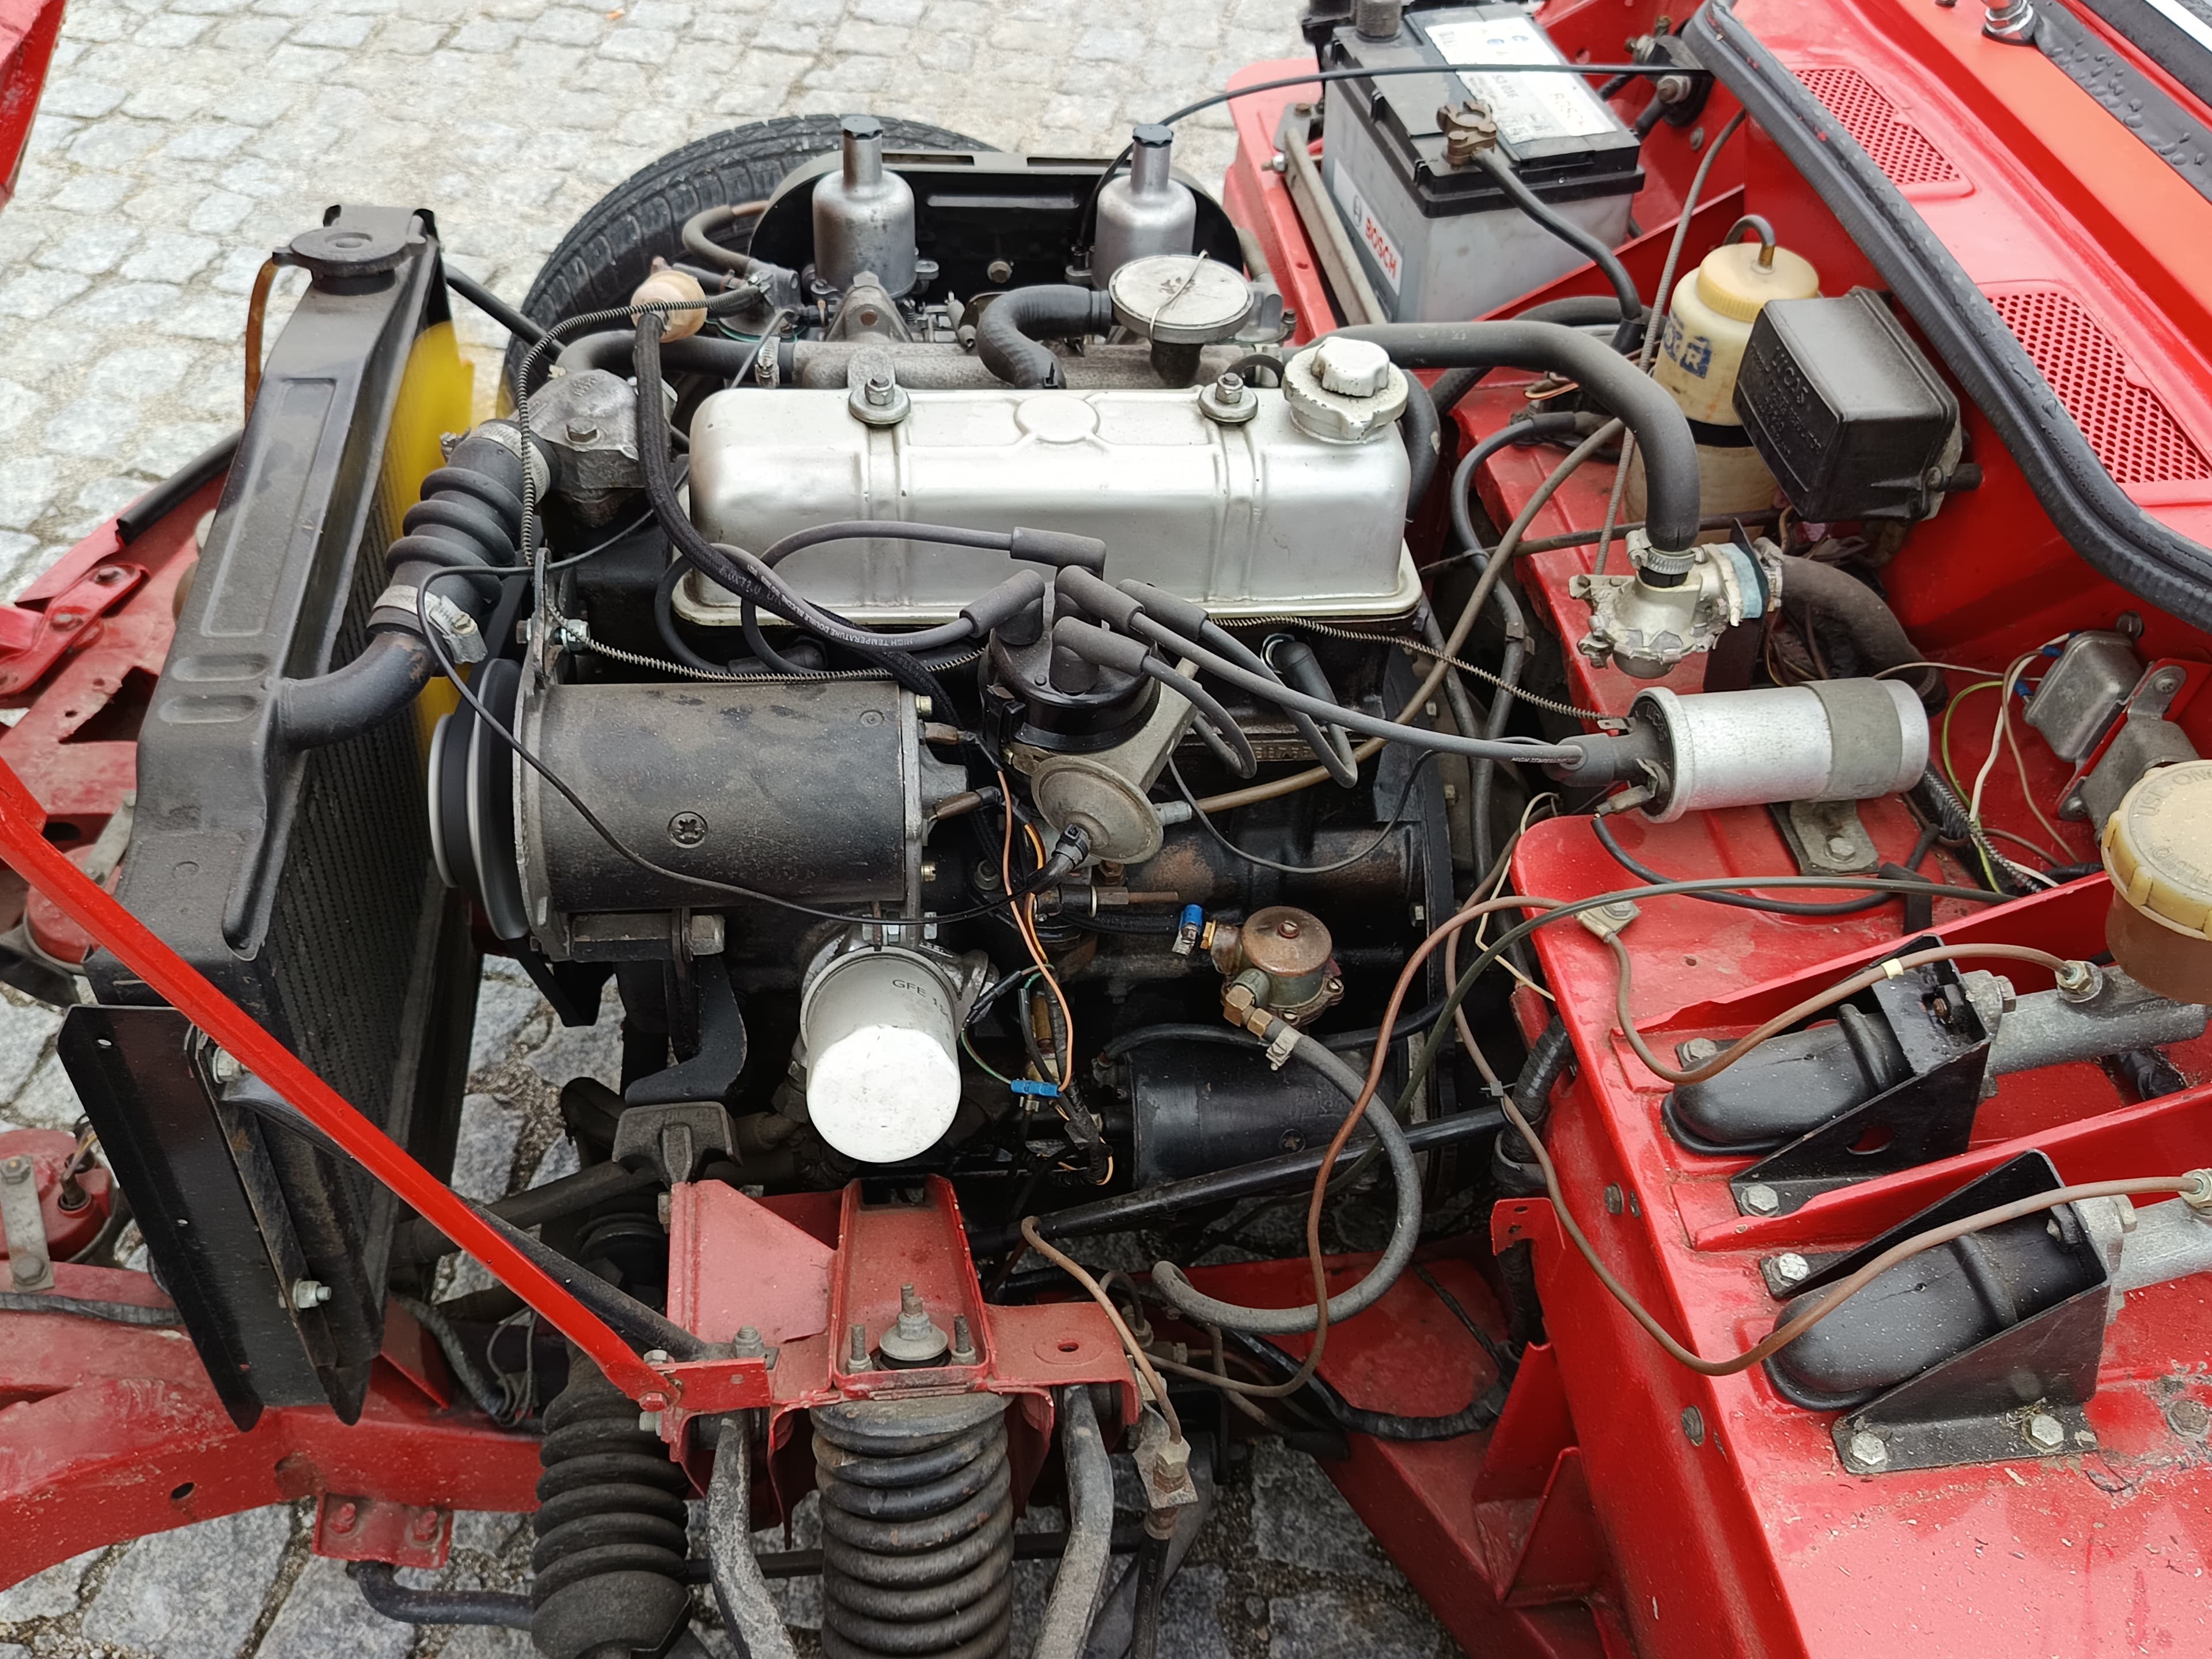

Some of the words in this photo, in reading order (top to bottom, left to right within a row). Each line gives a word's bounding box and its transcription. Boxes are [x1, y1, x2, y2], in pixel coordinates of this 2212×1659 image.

[1366, 217, 1397, 279] BOSCH
[804, 613, 830, 635] DOUBLE
[830, 628, 889, 646] TEMPERATURE
[891, 638, 912, 646] HIGH
[892, 979, 927, 998] GFE
